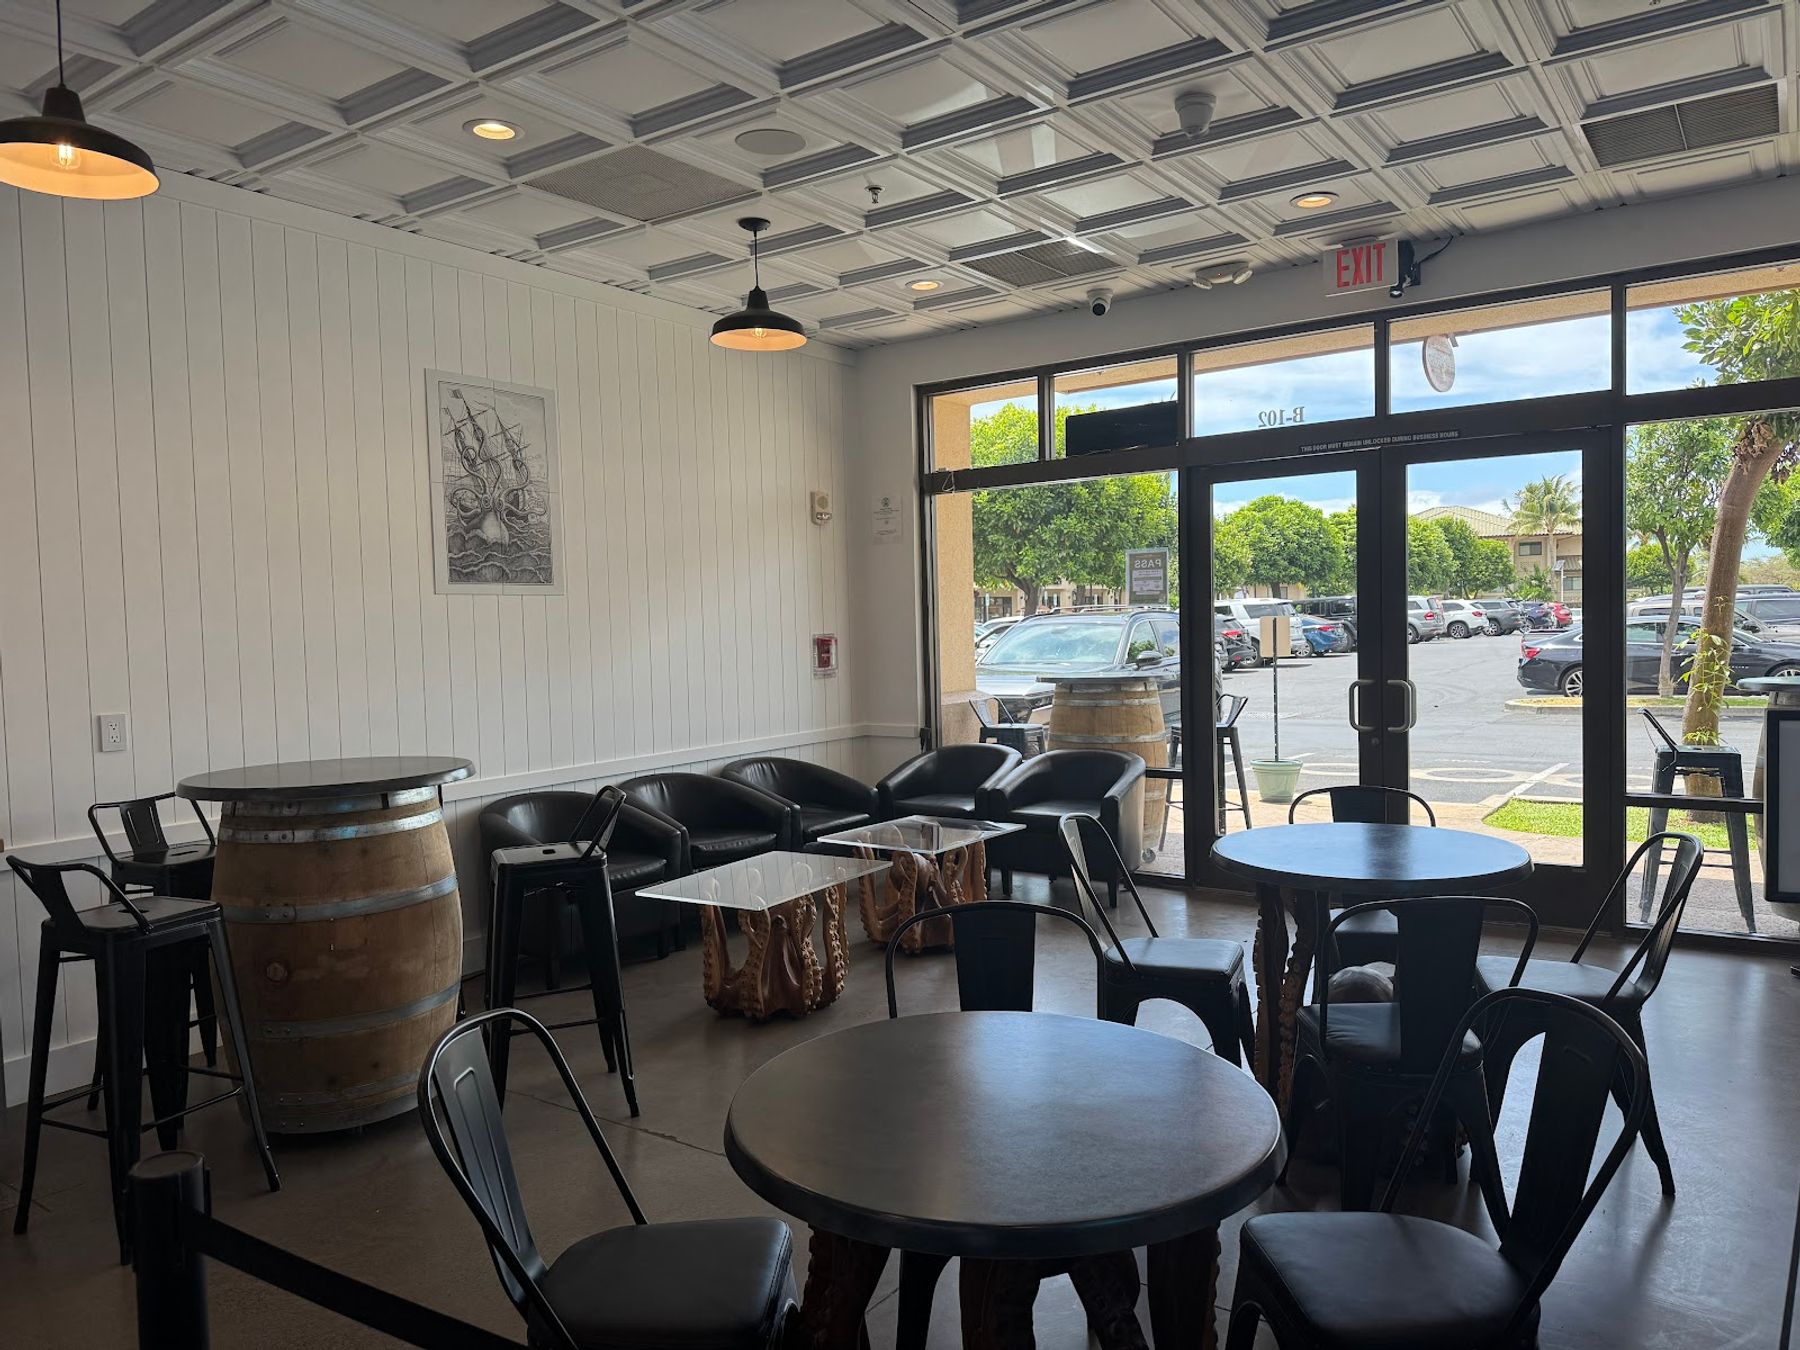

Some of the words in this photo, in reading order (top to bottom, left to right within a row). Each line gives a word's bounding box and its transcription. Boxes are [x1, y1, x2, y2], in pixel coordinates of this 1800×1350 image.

[1336, 243, 1386, 288] EXIT
[1362, 437, 1391, 446] UNLOCKED
[1412, 432, 1439, 441] BUSINESS
